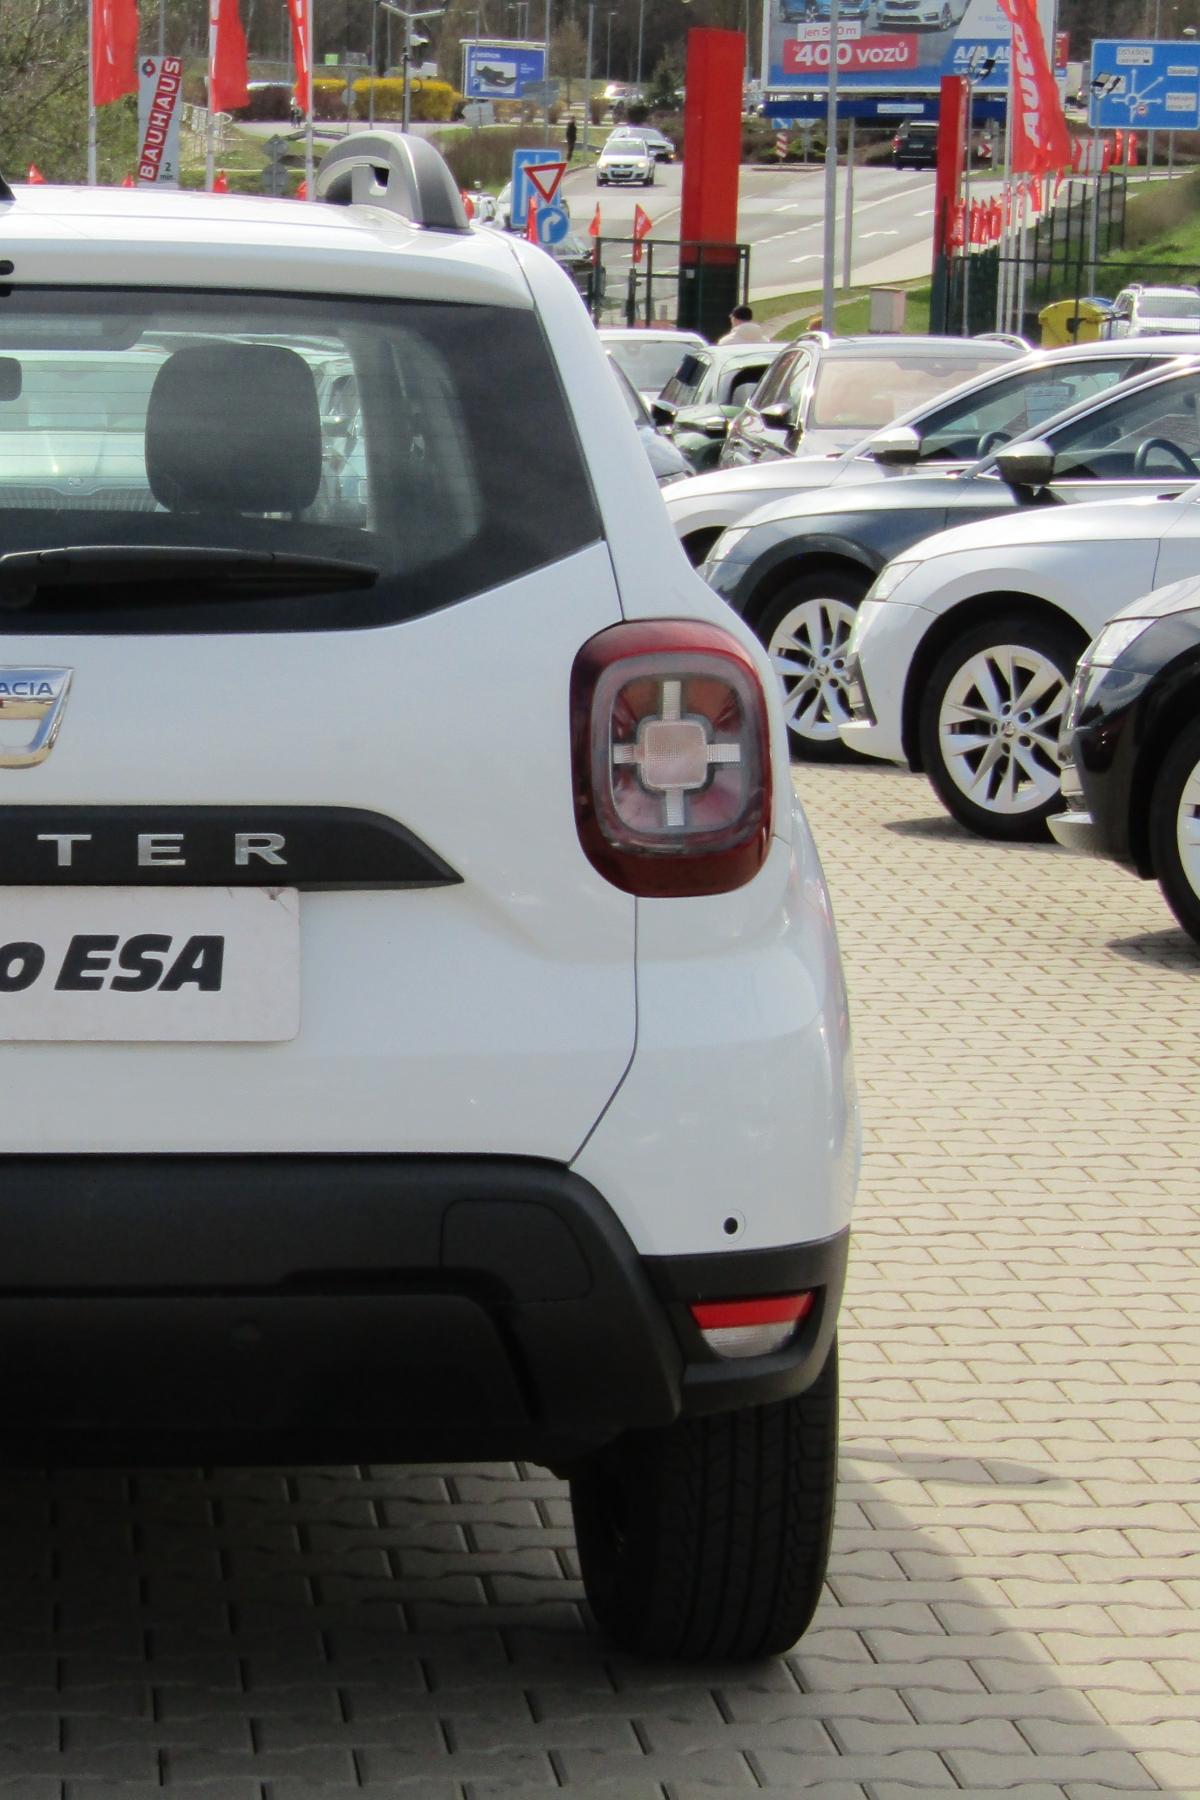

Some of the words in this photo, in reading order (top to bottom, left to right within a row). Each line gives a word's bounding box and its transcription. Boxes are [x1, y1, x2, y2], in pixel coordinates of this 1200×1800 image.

[803, 27, 820, 38] jen
[822, 26, 844, 36] 50
[846, 27, 856, 35] m
[795, 43, 852, 66] 400
[140, 59, 180, 179] BAUHAUS
[164, 162, 172, 172] 2
[54, 934, 225, 993] ESA
